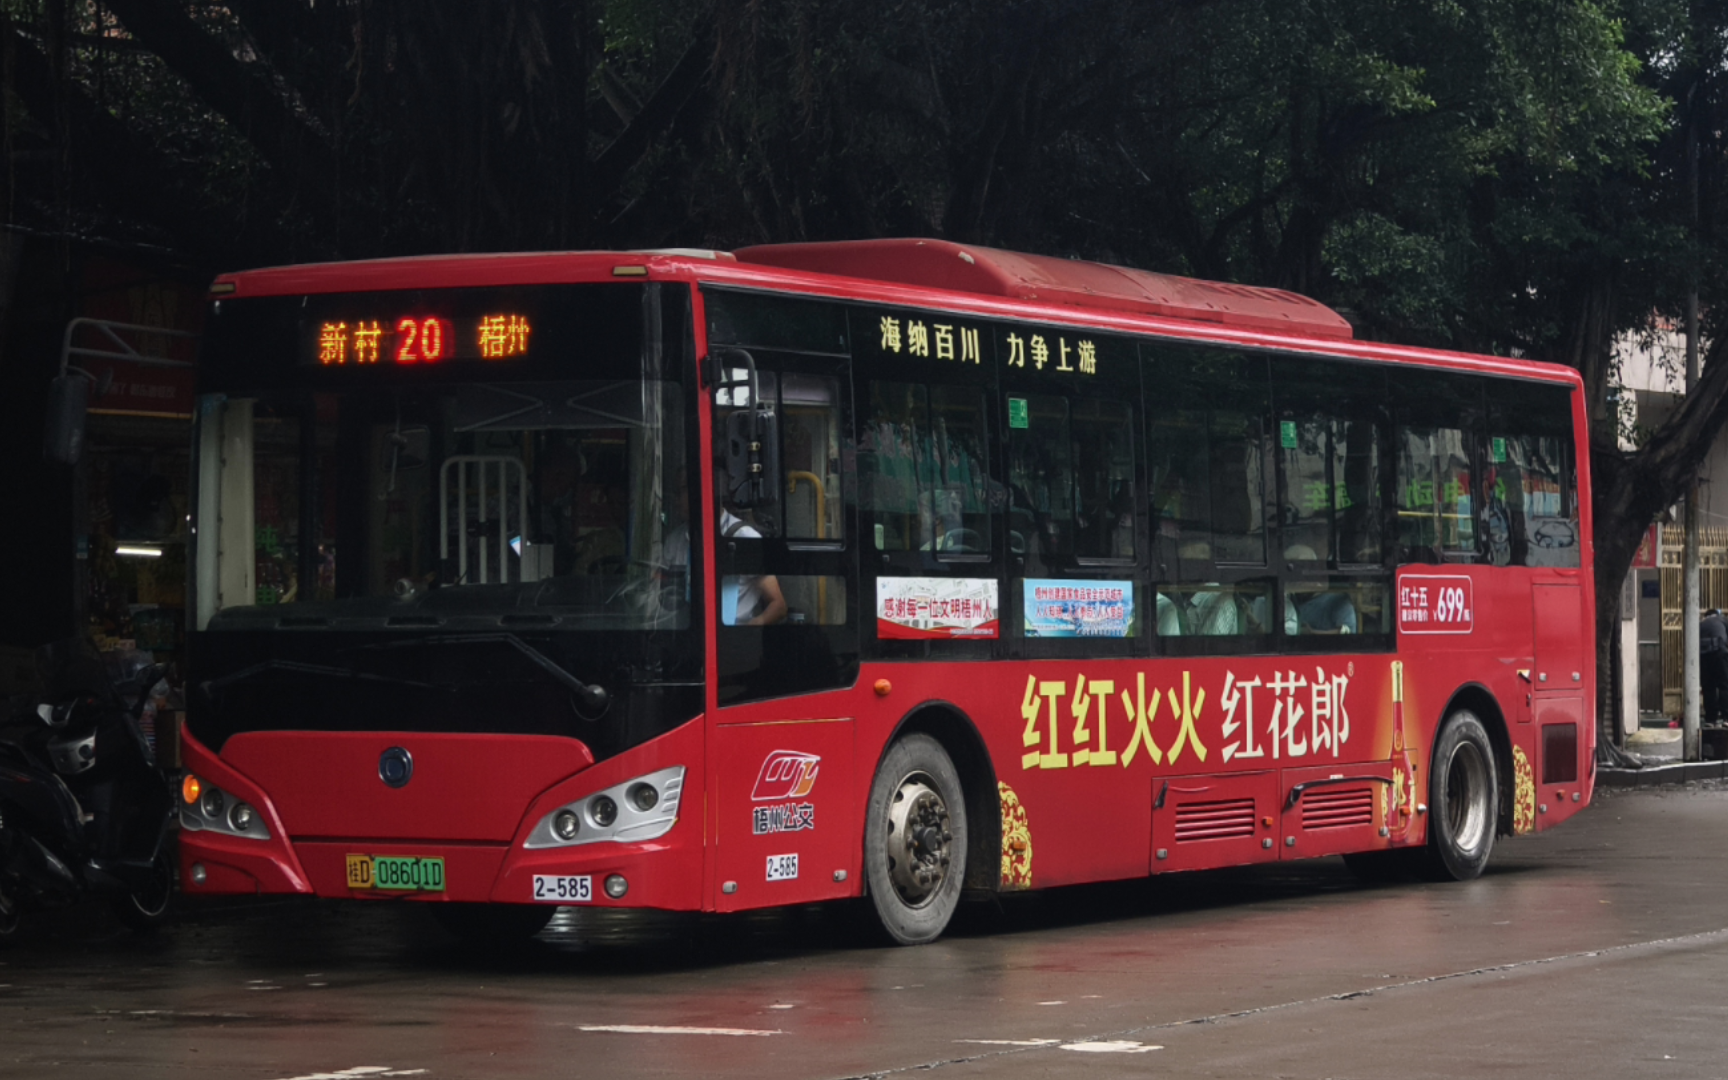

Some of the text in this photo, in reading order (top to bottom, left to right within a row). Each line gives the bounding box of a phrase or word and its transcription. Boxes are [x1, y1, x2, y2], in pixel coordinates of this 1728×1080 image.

[320, 315, 529, 363] 新村 20 梧州
[880, 316, 1097, 374] 海纳百川 力争上游
[884, 598, 992, 618] 感谢每一位文明梧州人
[1401, 586, 1428, 607] 红十五
[1021, 667, 1350, 770] 红红火火 红花郎
[753, 802, 814, 834] 梧州公交
[767, 856, 797, 878] 2-585
[535, 877, 590, 898] 2-585
